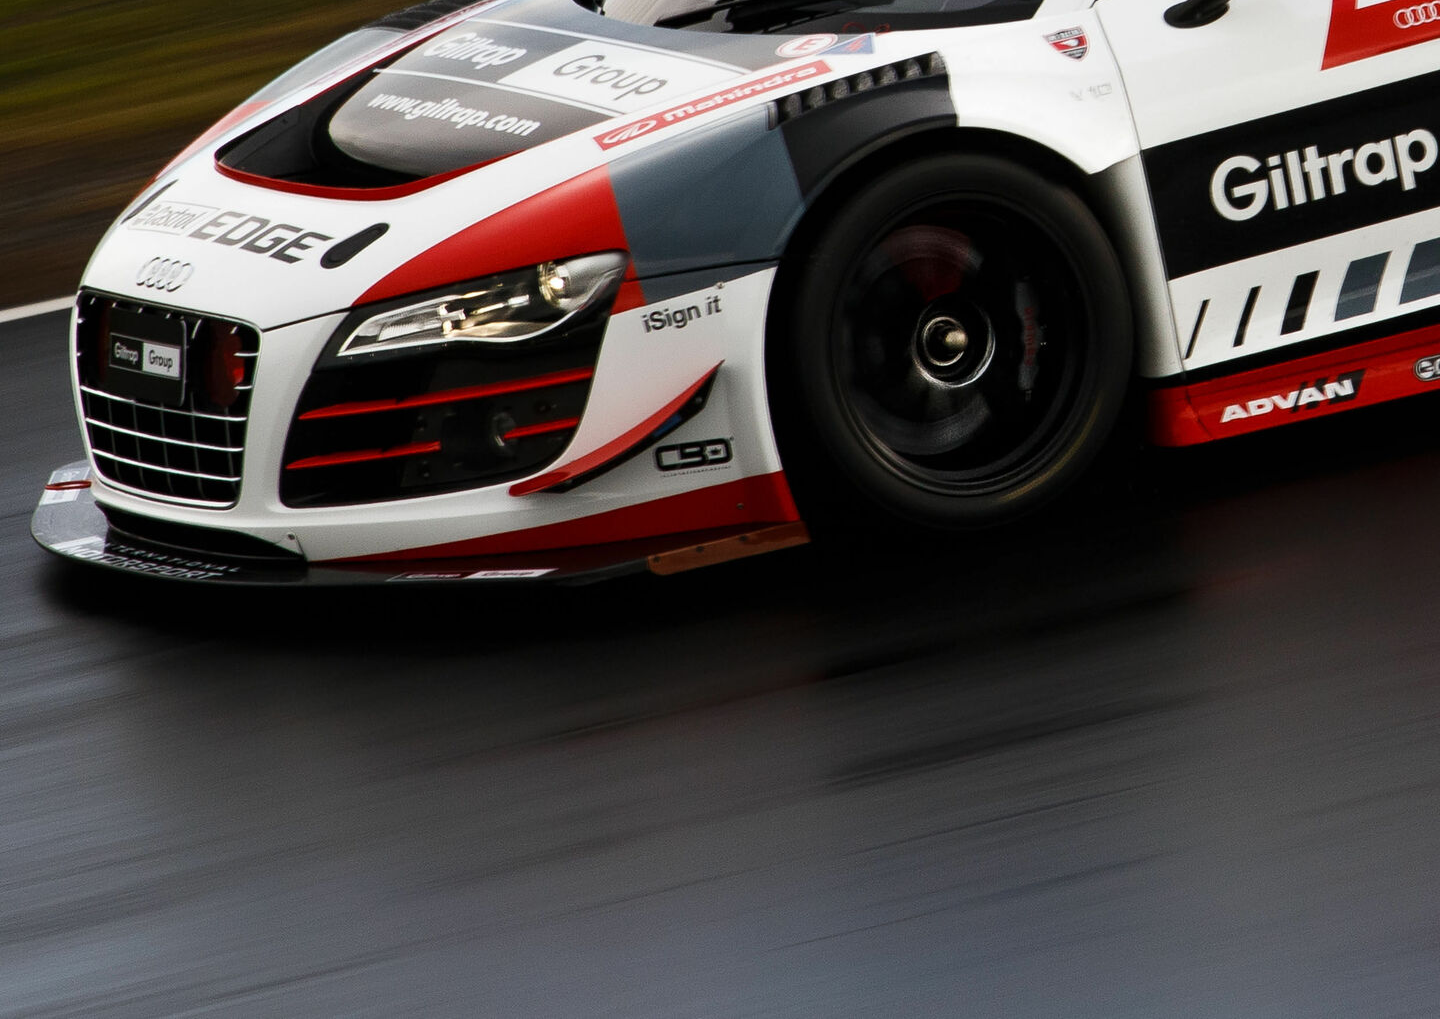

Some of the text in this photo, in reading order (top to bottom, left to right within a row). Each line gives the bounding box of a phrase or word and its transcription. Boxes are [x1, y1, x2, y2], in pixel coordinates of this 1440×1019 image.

[423, 32, 668, 101] Giltrap Group
[366, 92, 542, 137] www.giltrap.com
[1209, 126, 1439, 223] Giltrap
[188, 210, 335, 265] EDGE
[641, 294, 723, 334] iSign it
[148, 349, 174, 373] Group
[1220, 378, 1355, 424] ADVAN
